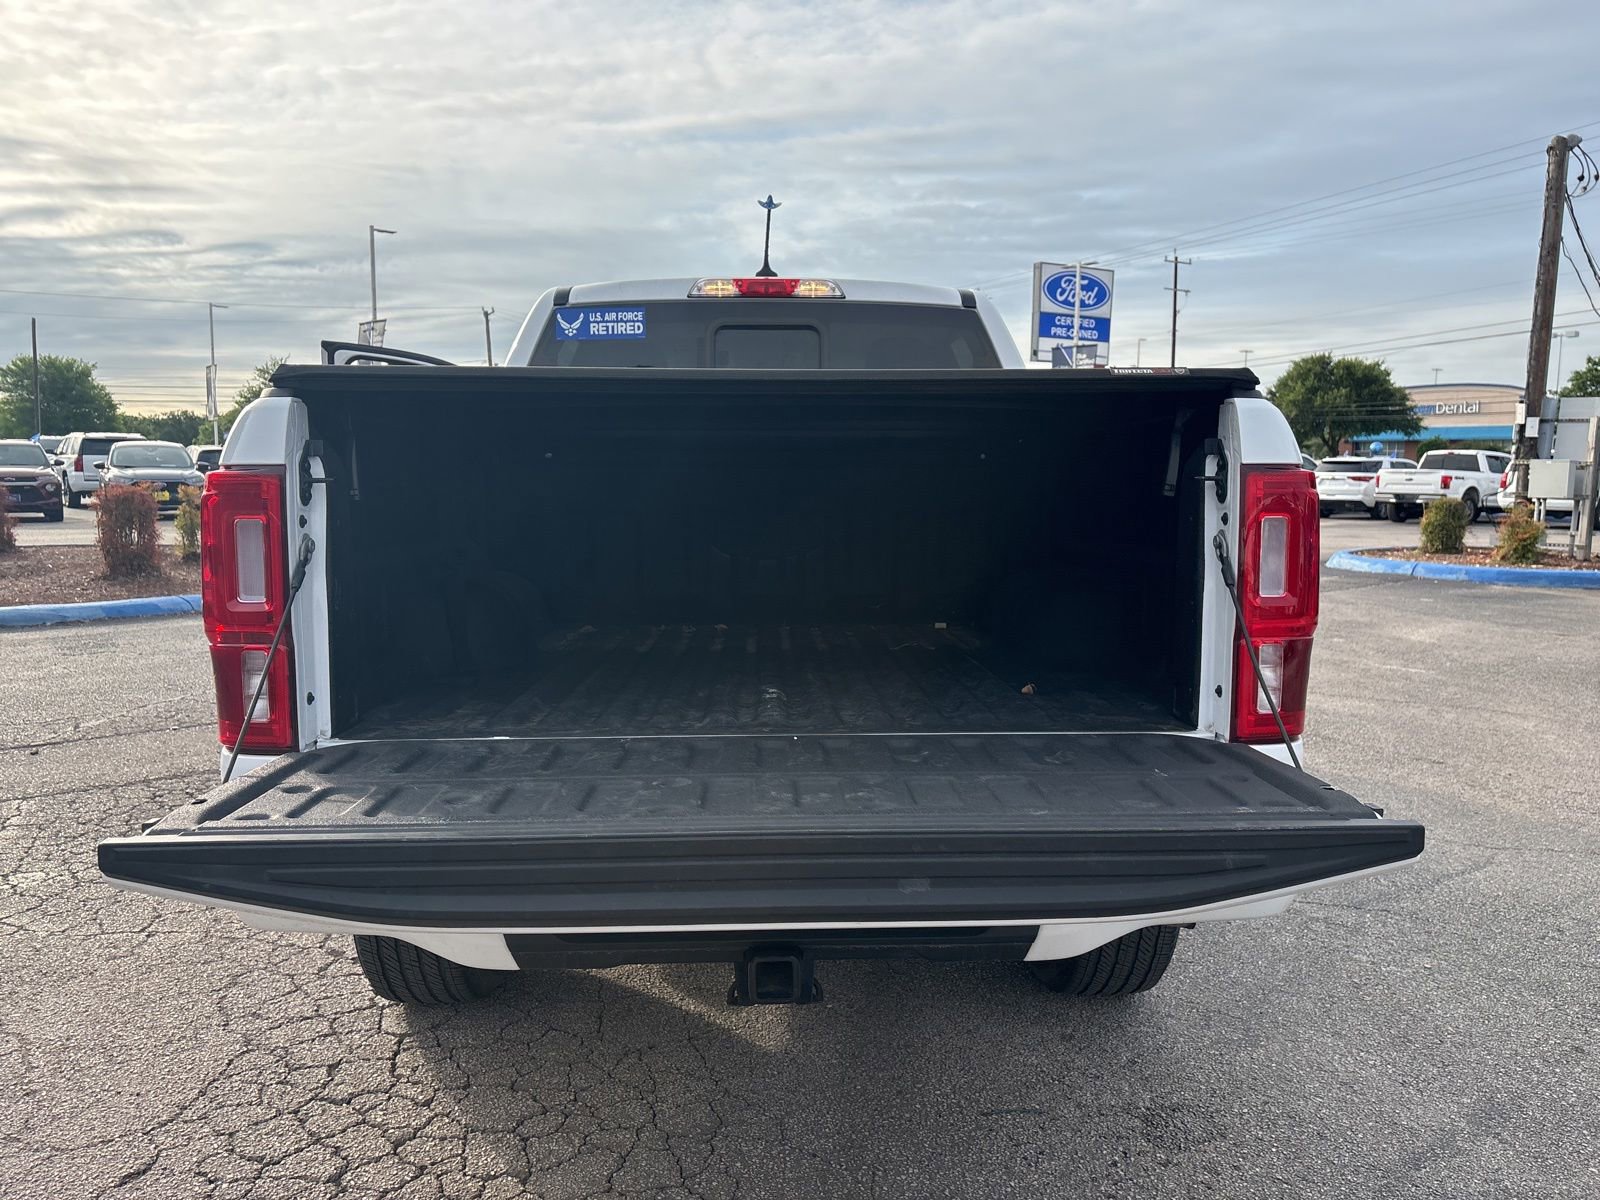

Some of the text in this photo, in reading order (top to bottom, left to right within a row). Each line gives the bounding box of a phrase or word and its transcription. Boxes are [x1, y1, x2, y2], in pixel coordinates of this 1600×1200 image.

[1056, 276, 1099, 305] Ford
[589, 311, 643, 321] U.S. AIR FORCE
[1055, 316, 1096, 328] CERFIED
[590, 322, 644, 335] RETIRED
[1436, 400, 1479, 414] Dental
